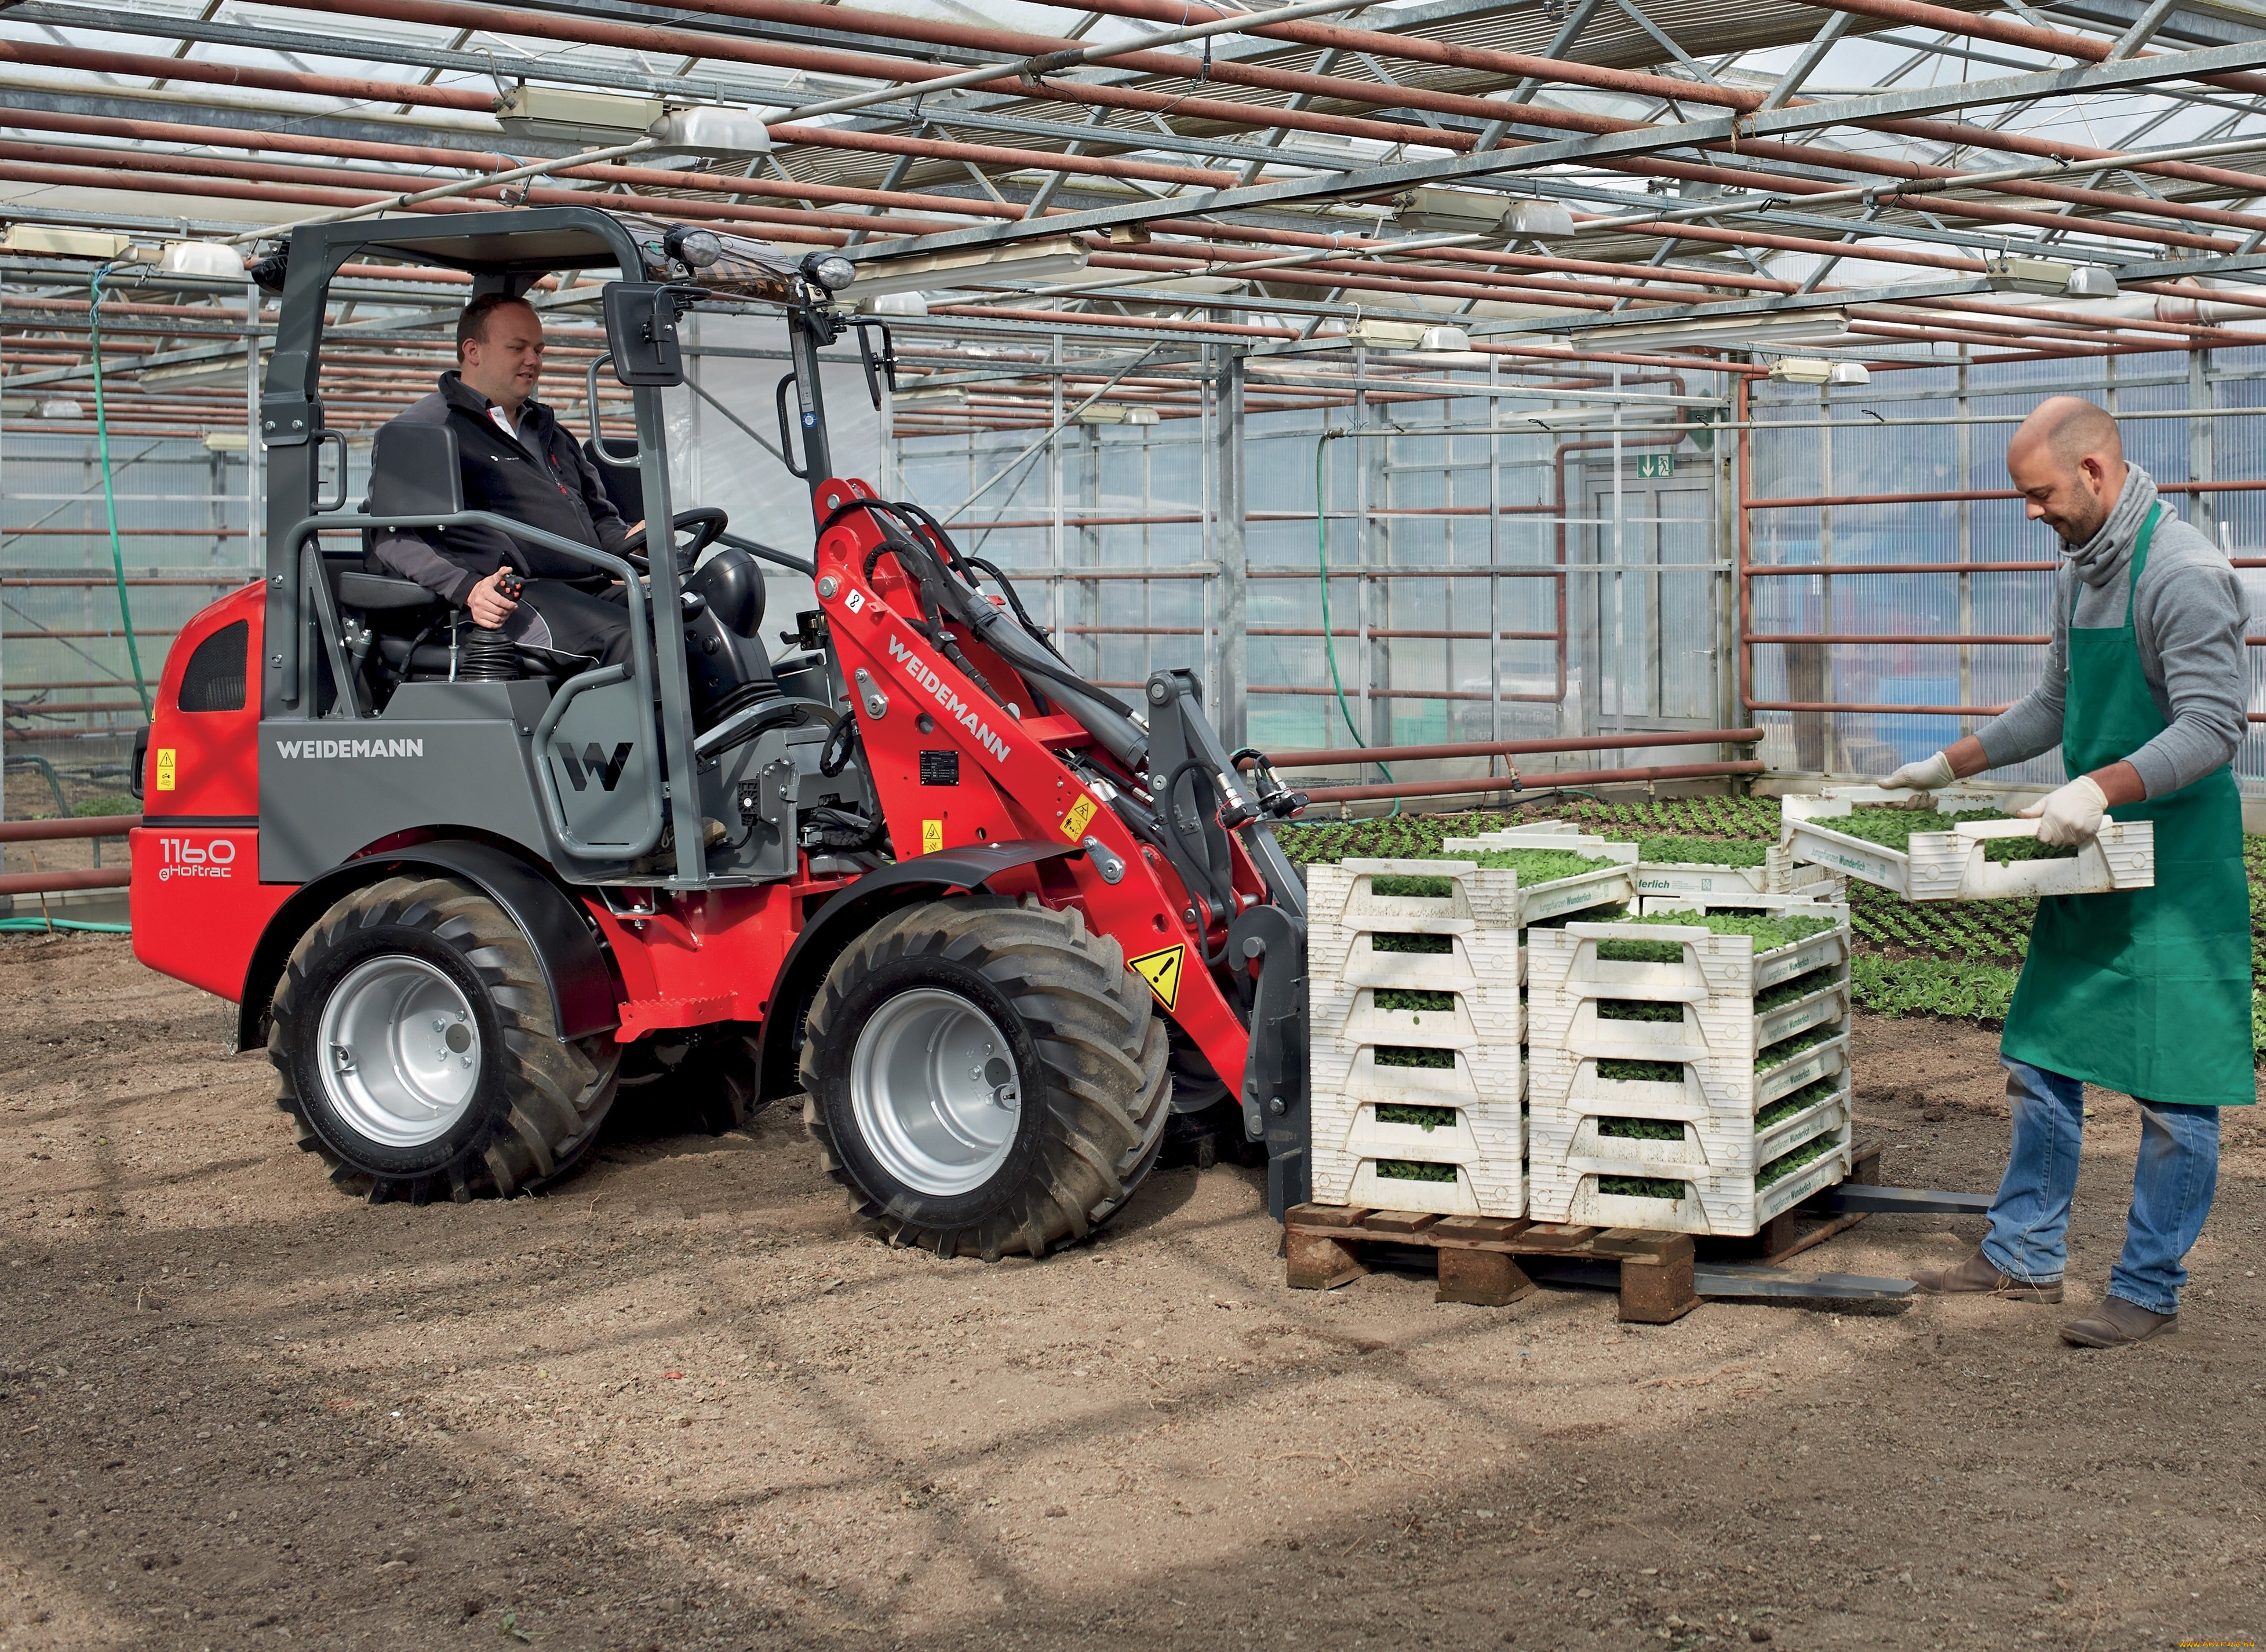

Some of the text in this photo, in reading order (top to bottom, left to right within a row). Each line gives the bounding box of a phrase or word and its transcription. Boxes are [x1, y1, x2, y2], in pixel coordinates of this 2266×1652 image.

[888, 633, 1011, 763] WEIDEMANN
[276, 738, 424, 759] WEIDEMANN
[555, 742, 634, 792] W
[159, 838, 236, 863] 1160
[159, 864, 232, 881] eHoftrac
[1839, 854, 1866, 872] Wunderlich
[1539, 899, 1566, 913] Jungpflanzen
[1566, 892, 1592, 906] Wunderlich
[1790, 1067, 1810, 1085] Wunderlich
[1790, 1125, 1810, 1144] Wunderlich
[1790, 1179, 1812, 1201] Wunderlich
